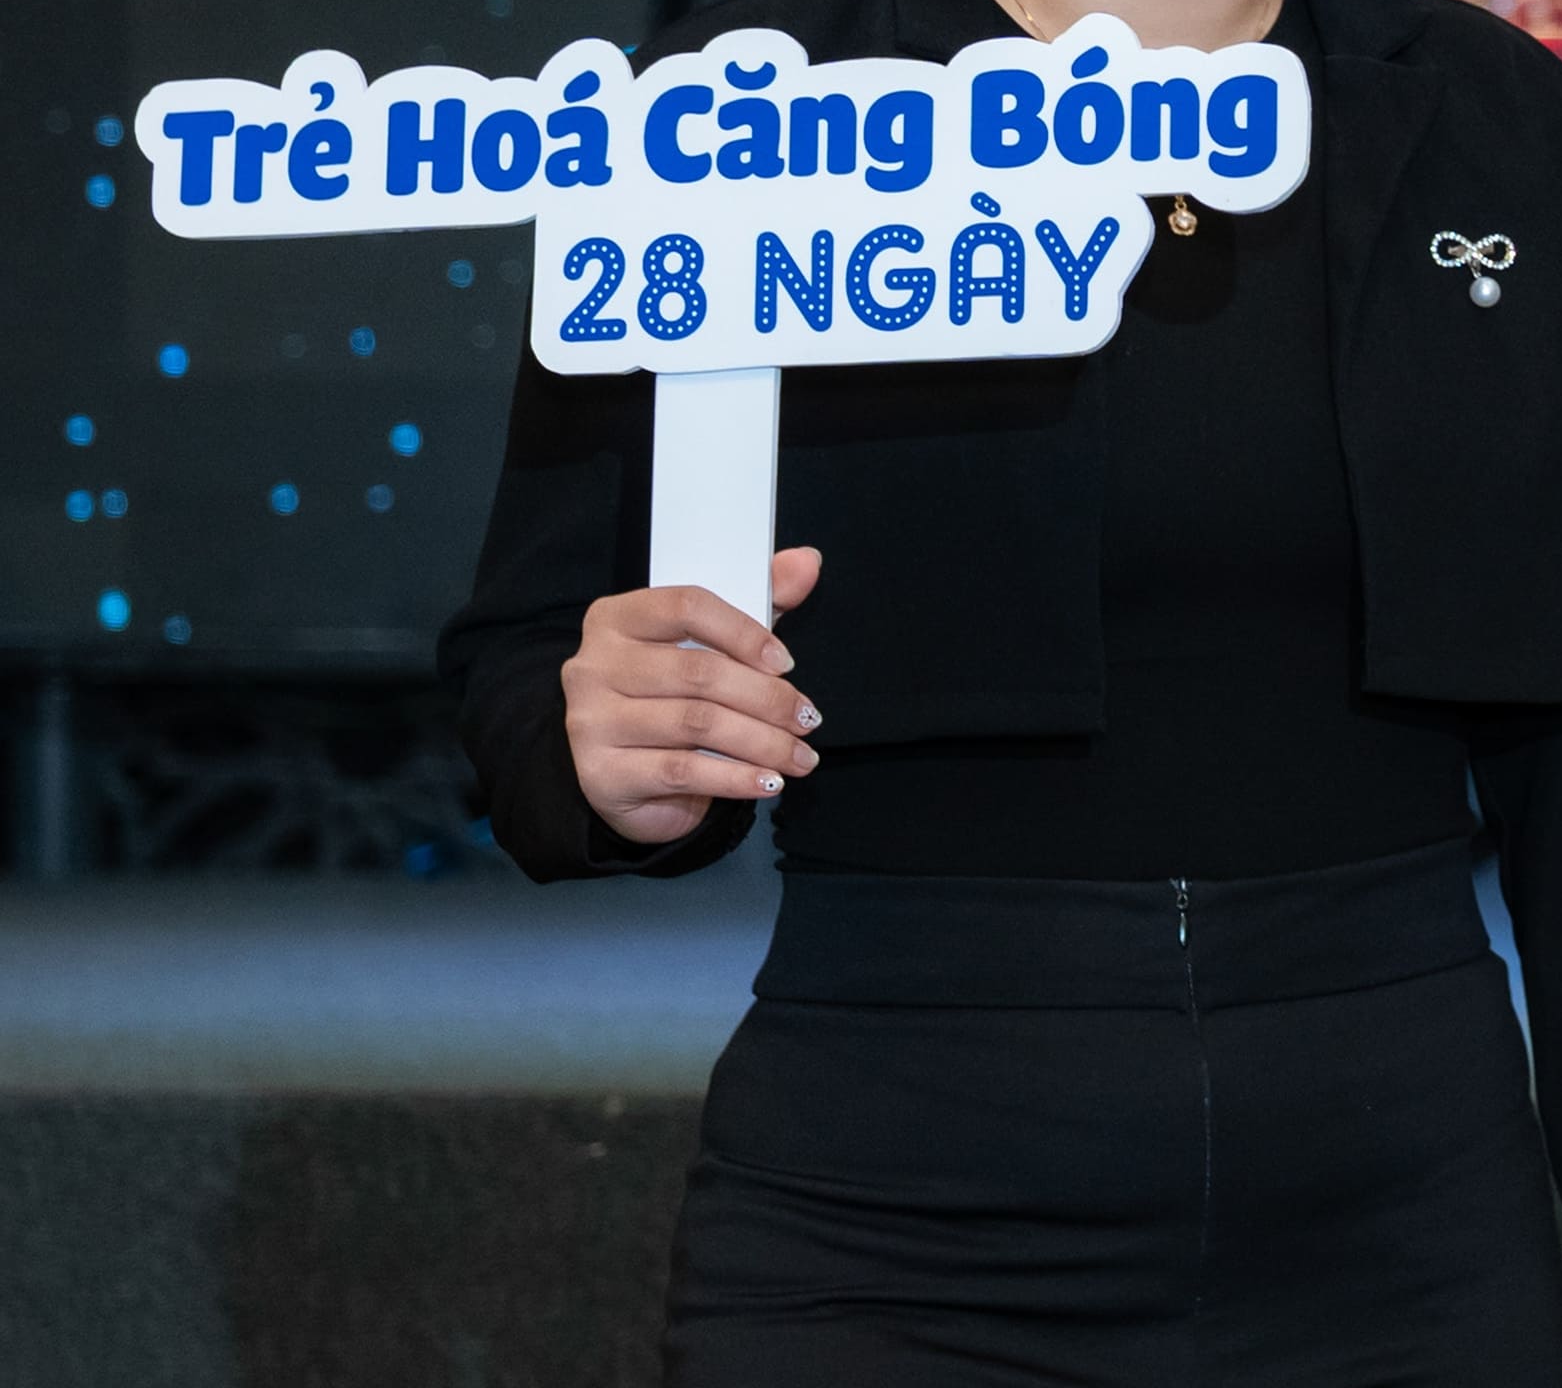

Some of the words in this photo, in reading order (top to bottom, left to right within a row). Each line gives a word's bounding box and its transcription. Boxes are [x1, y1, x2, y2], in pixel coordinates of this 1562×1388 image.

[162, 80, 353, 207] Trẻ
[385, 70, 613, 197] Hoá
[643, 60, 934, 193] Căng
[970, 45, 1279, 179] Bóng
[559, 233, 708, 343] 28
[754, 191, 1121, 334] NGÀY
